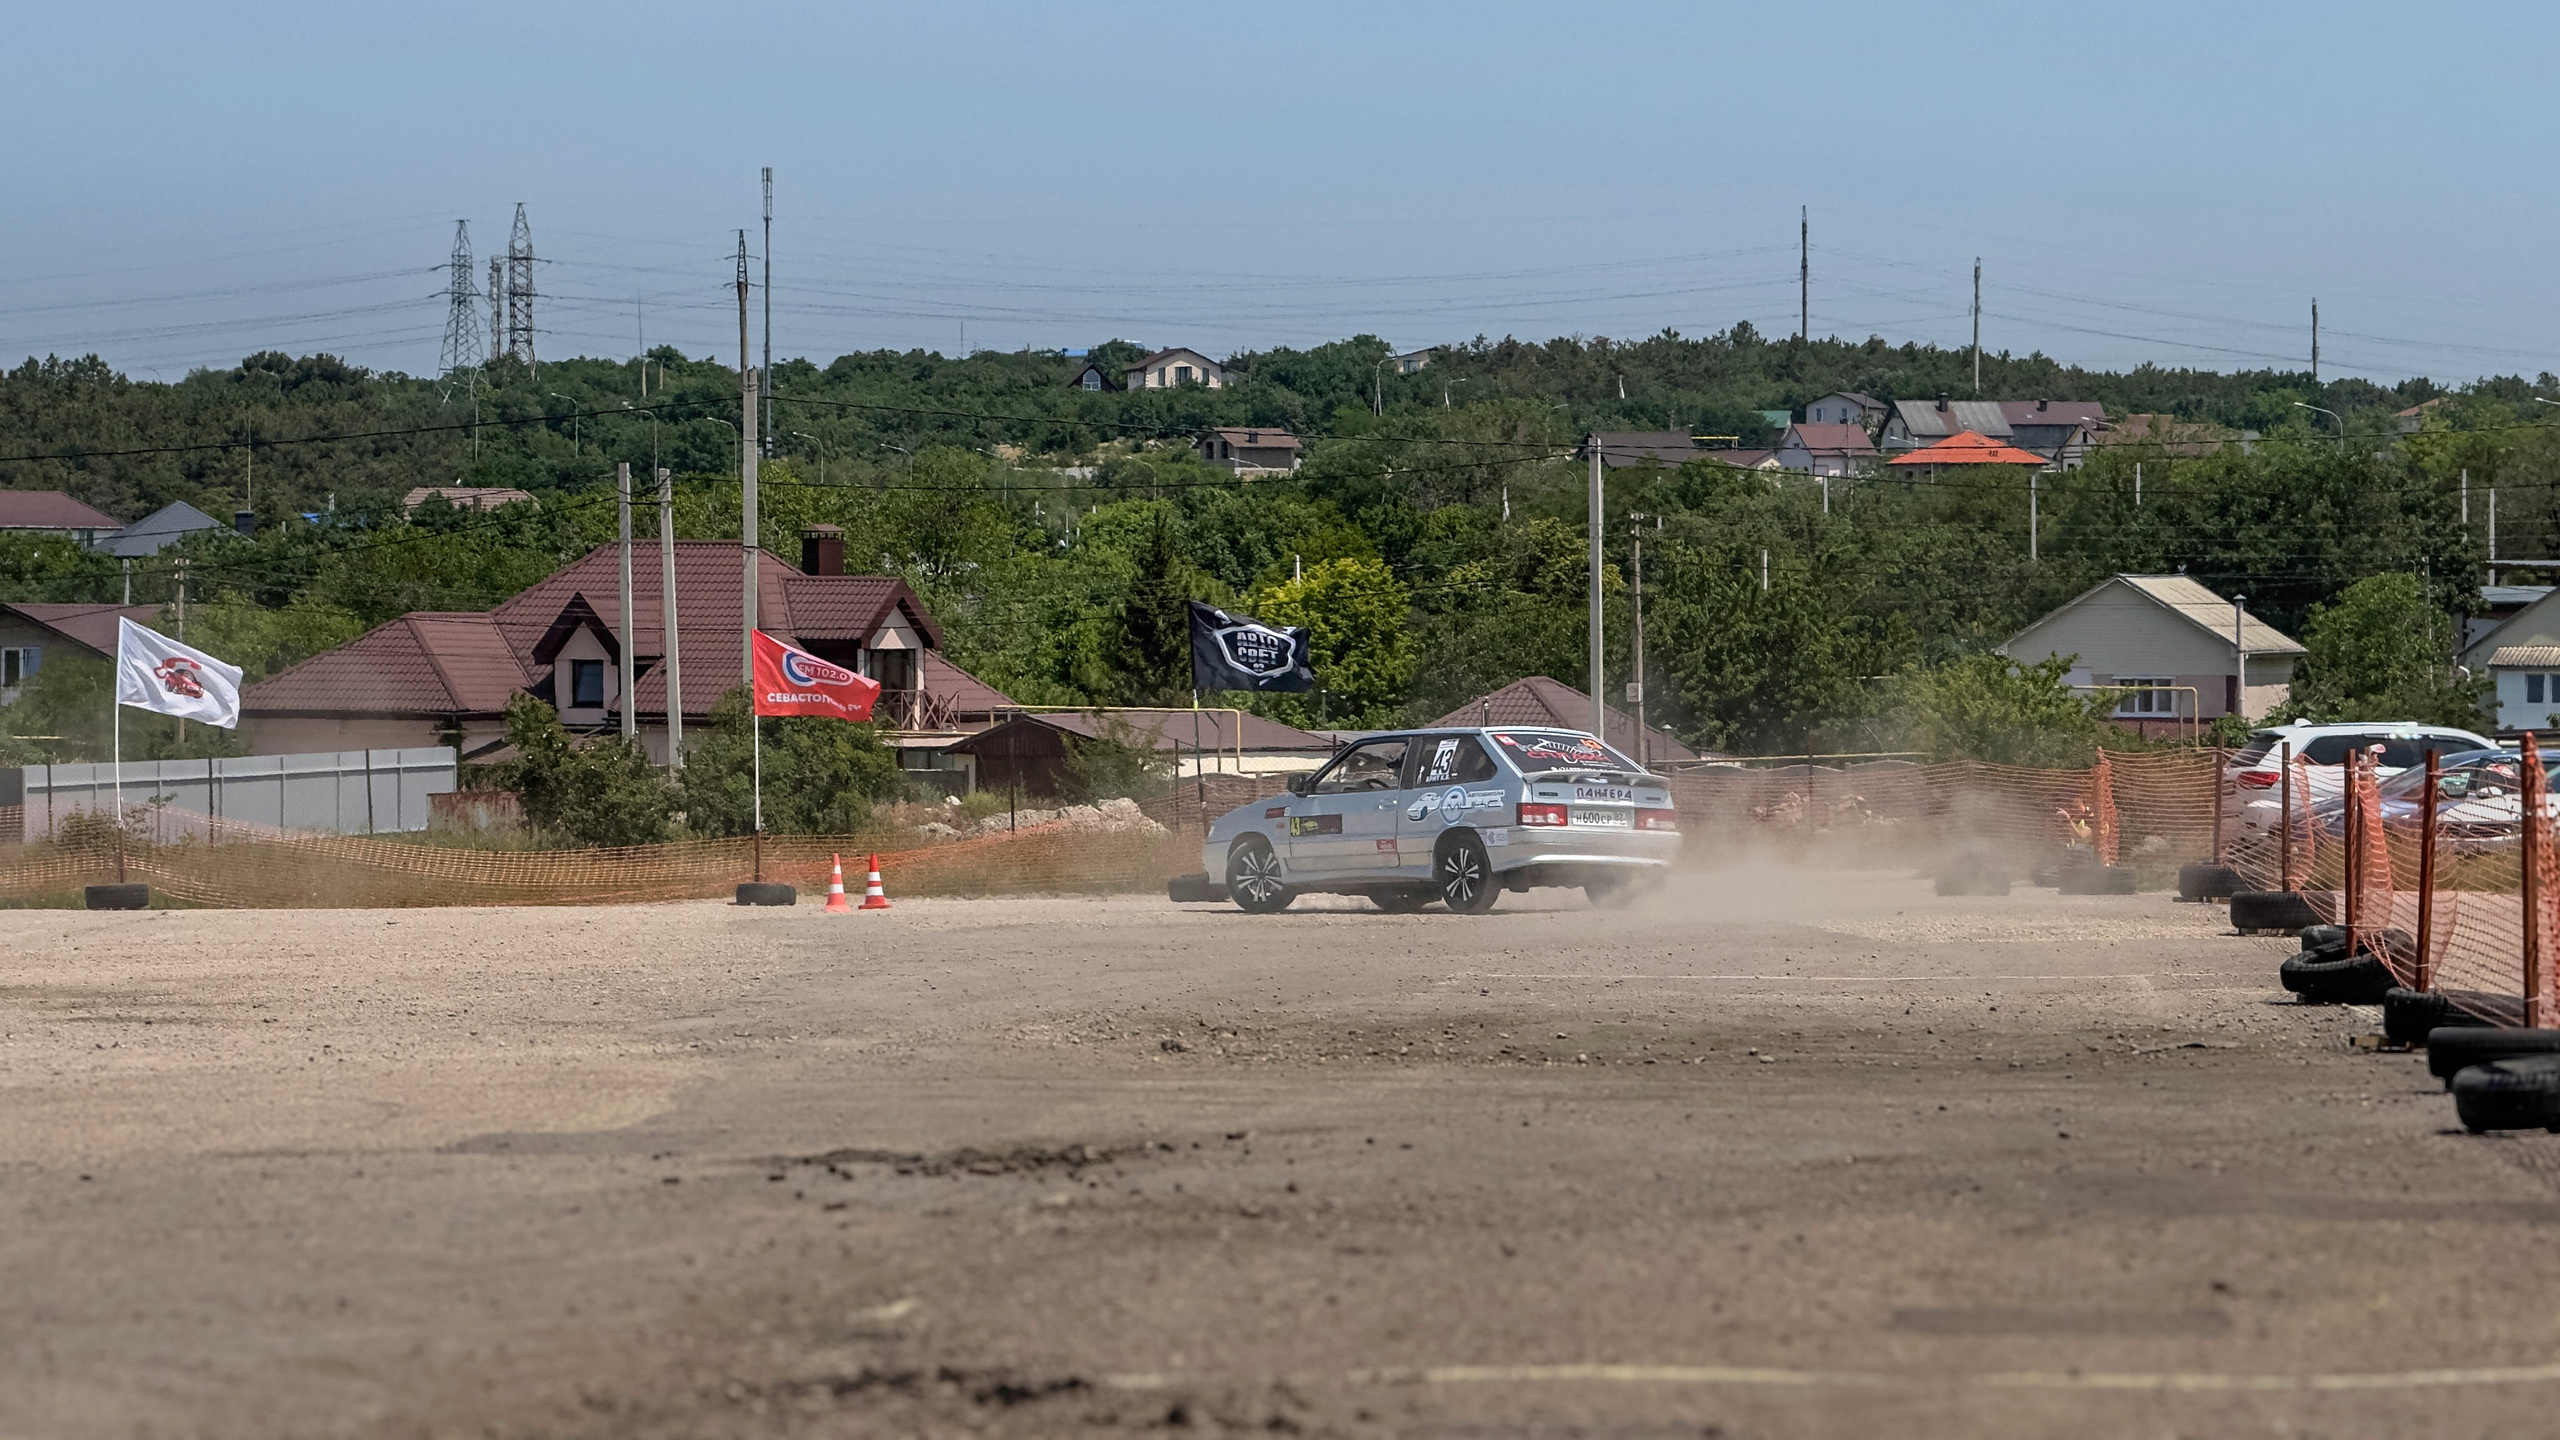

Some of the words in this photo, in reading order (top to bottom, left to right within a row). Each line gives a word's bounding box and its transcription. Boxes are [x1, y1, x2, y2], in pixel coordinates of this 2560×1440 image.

[1237, 631, 1279, 651] АВТО
[1238, 647, 1279, 665] СВЕТ
[798, 664, 815, 676] FM
[816, 668, 848, 681] 102.0
[1433, 749, 1454, 774] 43
[1577, 787, 1632, 802] ПАНТЕРА
